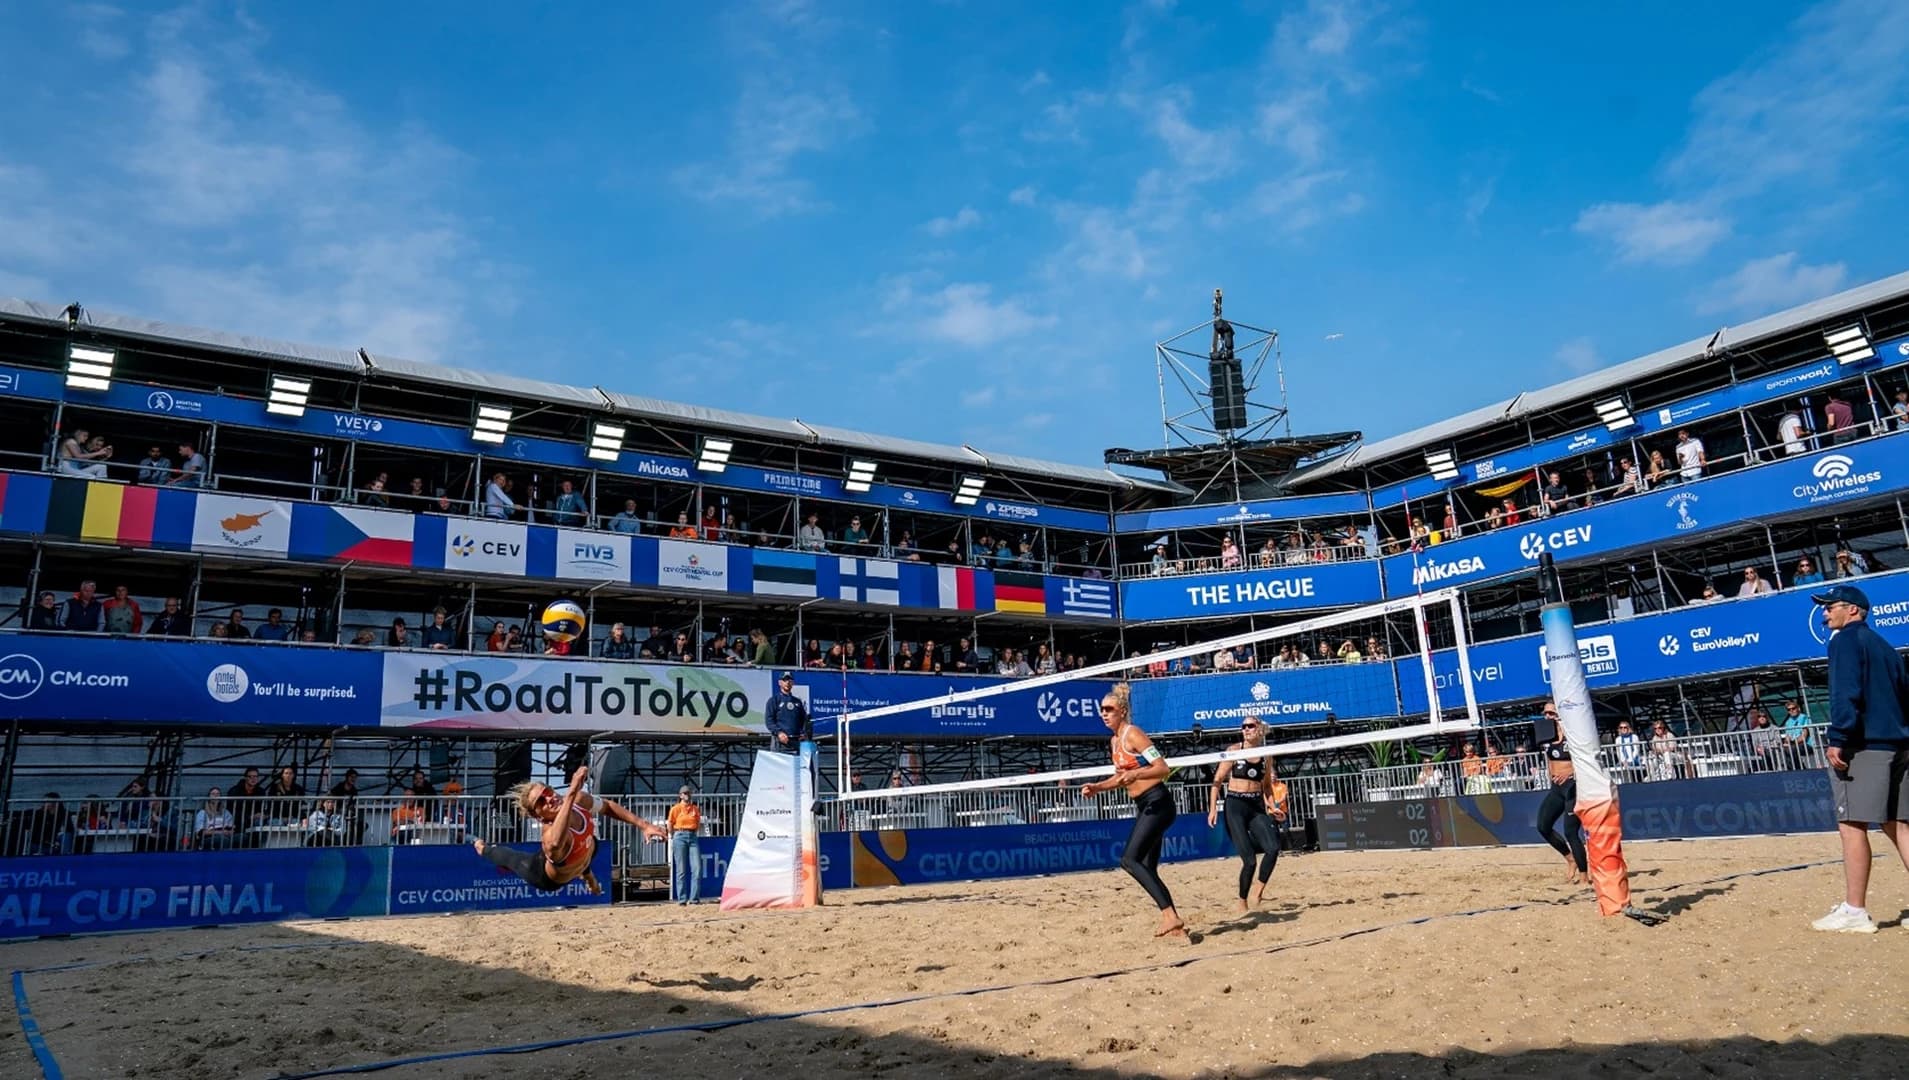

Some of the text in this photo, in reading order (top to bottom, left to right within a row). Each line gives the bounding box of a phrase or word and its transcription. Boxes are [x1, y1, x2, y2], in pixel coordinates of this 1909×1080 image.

[998, 503, 1038, 517] ZPRESS
[1549, 525, 1592, 549] CEV
[482, 542, 520, 557] CEV
[575, 543, 614, 561] FIVB
[1187, 577, 1315, 606] THE HAGUE
[1872, 601, 1909, 616] SIGHT
[1690, 626, 1711, 639] CEV
[1692, 632, 1760, 652] EuroVolleyTV
[1587, 661, 1615, 674] RENTAL
[50, 671, 129, 687] CM.com
[287, 684, 301, 697] be
[304, 685, 356, 701] surprised.
[414, 669, 749, 728] #RoadToTokyo
[1194, 702, 1332, 720] CEV CONTINENTAL CUP FINAL
[1406, 803, 1426, 820] 02
[1625, 806, 1684, 836] CEV
[1024, 828, 1112, 845] BEACH VOLLEYBALL
[1409, 828, 1429, 845] 02
[919, 852, 963, 877] CEV
[968, 844, 1105, 874] CONTINENTAL
[1160, 835, 1199, 858] INAL
[701, 852, 728, 879] Th
[473, 879, 496, 887] BEACH
[398, 890, 429, 904] CEV
[432, 886, 532, 903] CONTINENTAL
[567, 883, 605, 896] FINL
[67, 888, 157, 924] CUP
[167, 882, 283, 918] FINAL
